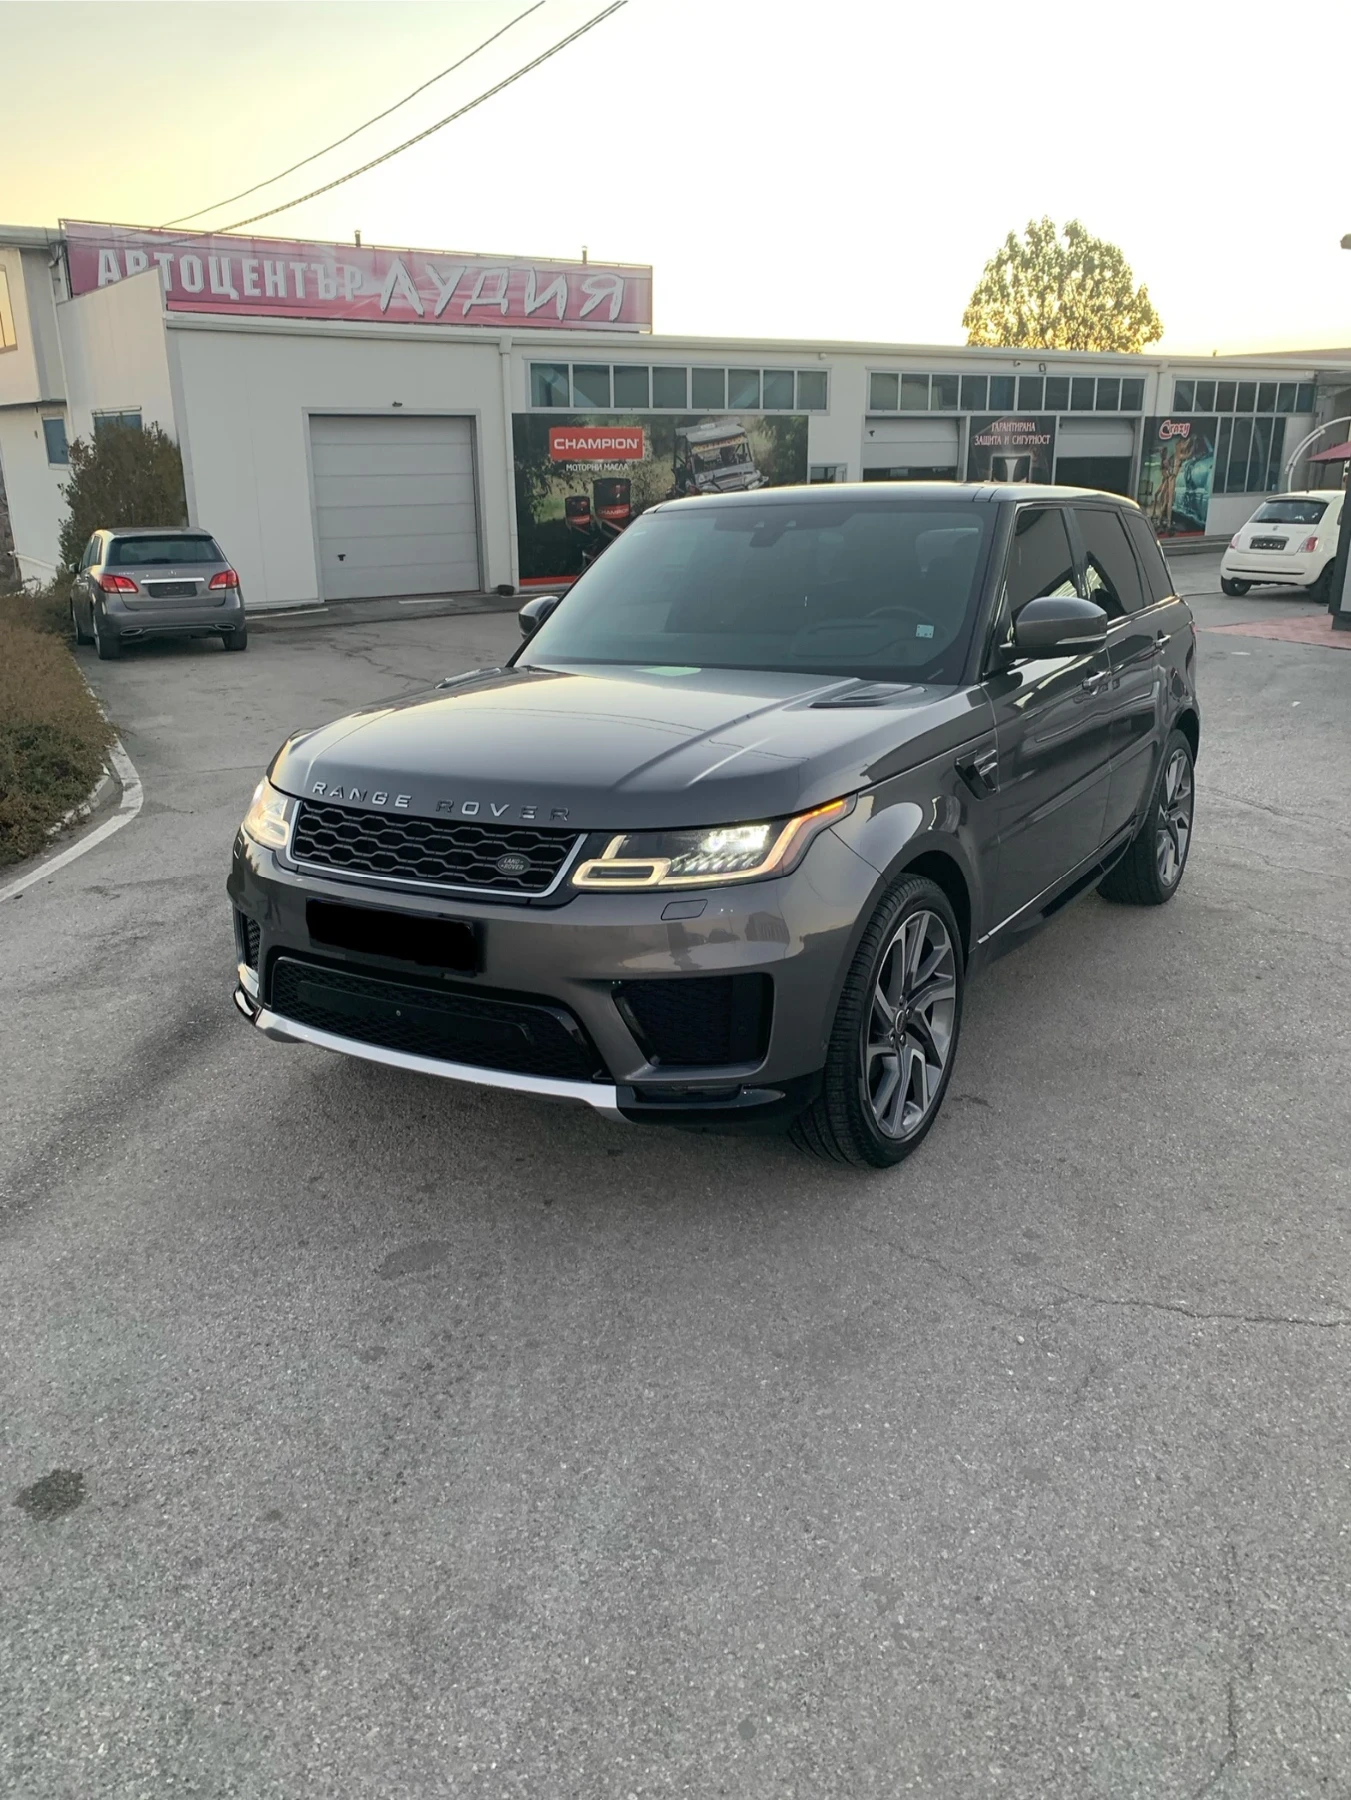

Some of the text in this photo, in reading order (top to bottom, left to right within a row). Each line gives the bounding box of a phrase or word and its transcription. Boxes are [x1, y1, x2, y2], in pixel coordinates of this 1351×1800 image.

[991, 421, 1036, 432] ГАРАНТИРАНА
[1159, 419, 1191, 440] Crazy
[554, 438, 638, 450] CHAMPION
[974, 434, 1051, 446] ЗАЩИТА И СИГУРНОСТ
[566, 463, 629, 472] МОТОРНИ МАСЛА
[311, 781, 571, 822] RANGE ROVER
